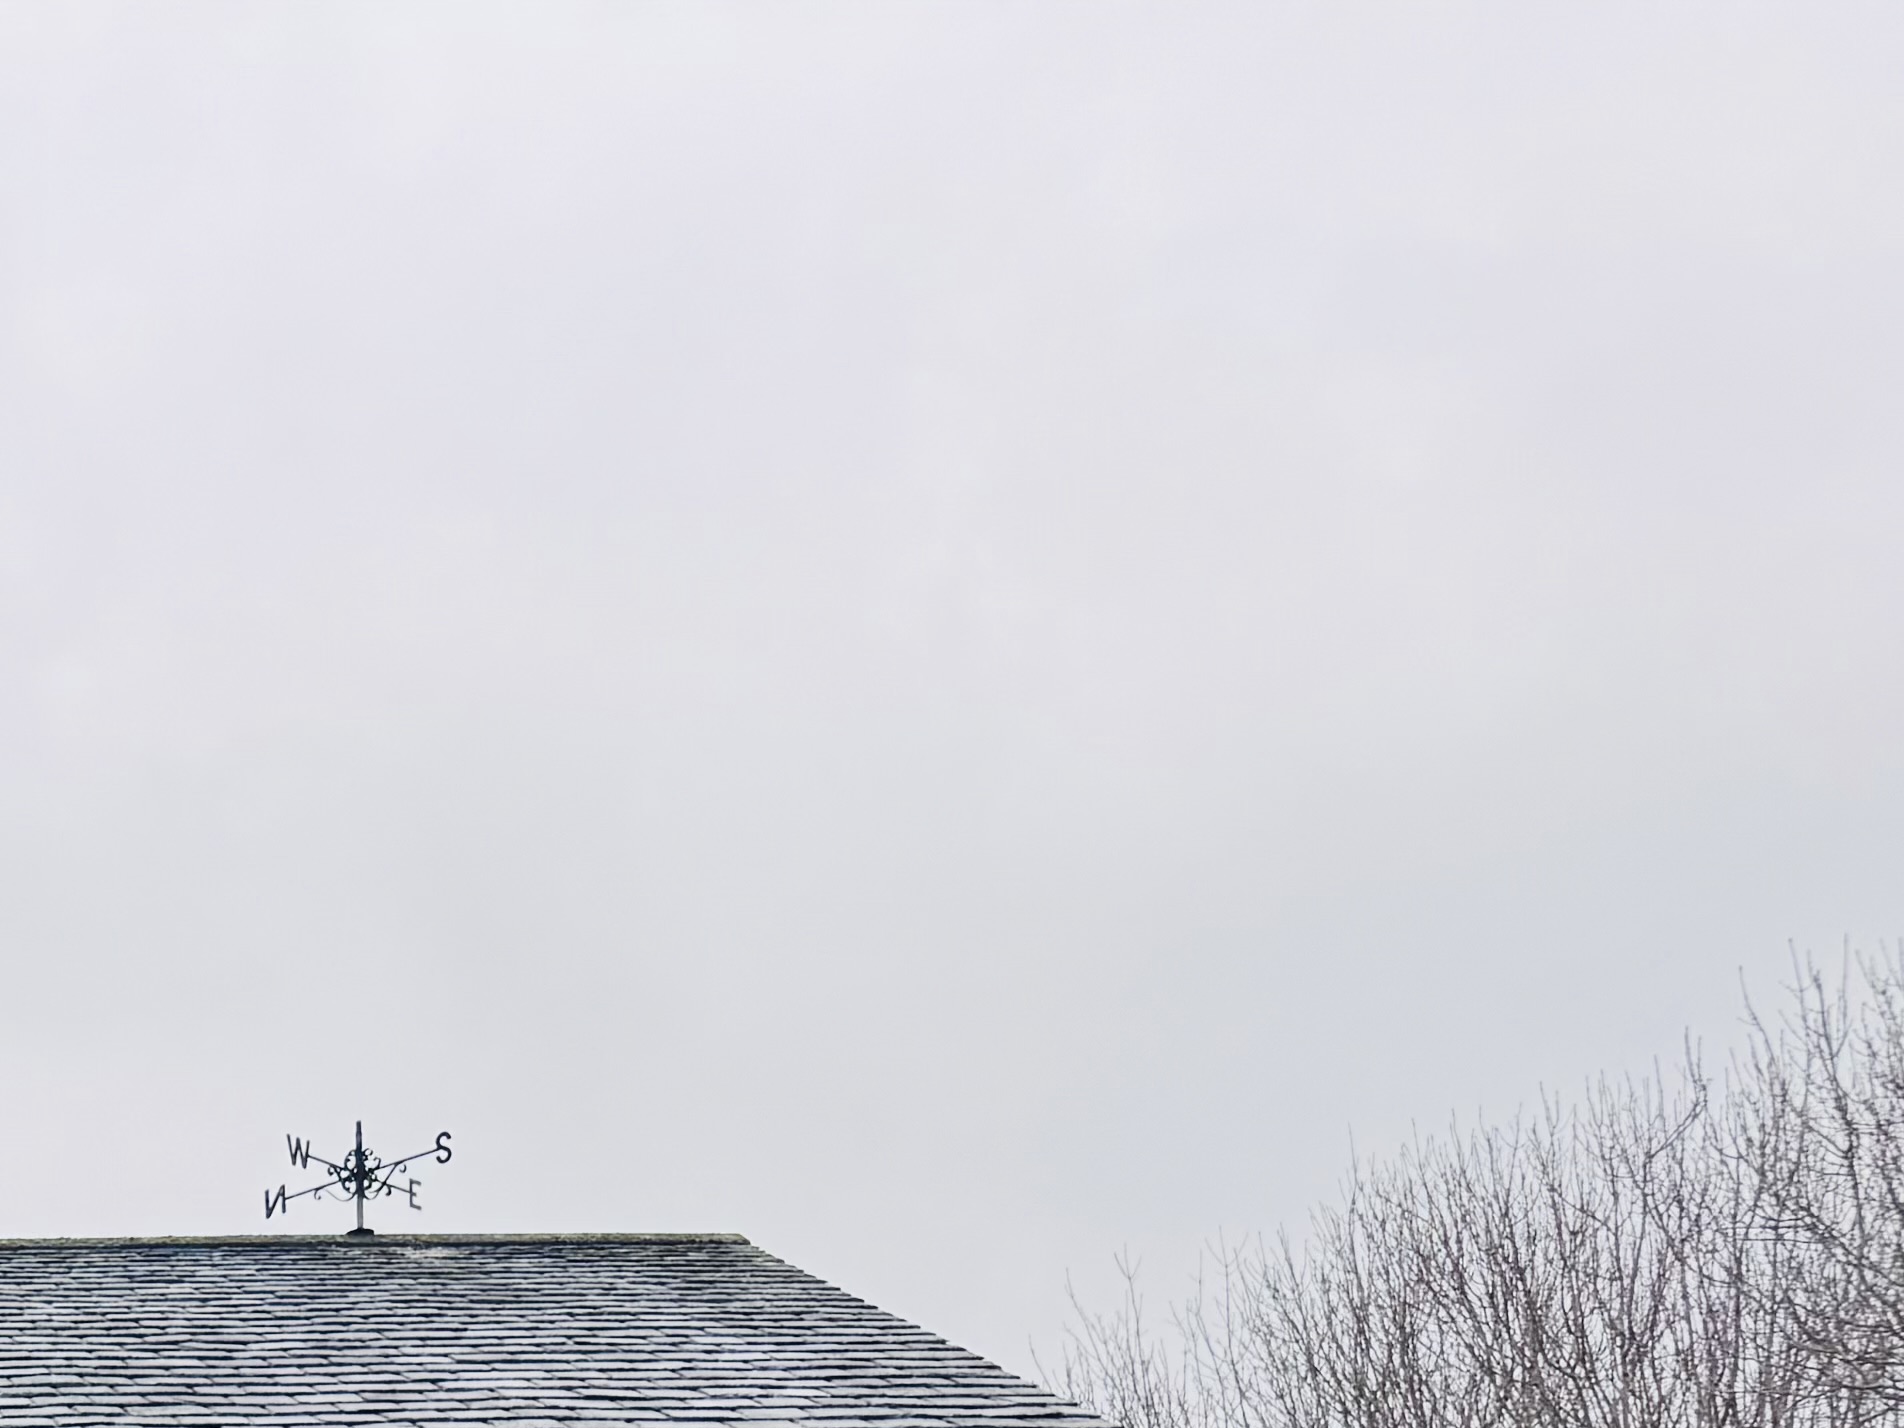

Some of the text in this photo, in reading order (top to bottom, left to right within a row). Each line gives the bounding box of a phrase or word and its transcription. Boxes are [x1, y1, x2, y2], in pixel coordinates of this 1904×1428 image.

[286, 1133, 310, 1169] W
[435, 1131, 452, 1164] S
[409, 1178, 422, 1210] E
